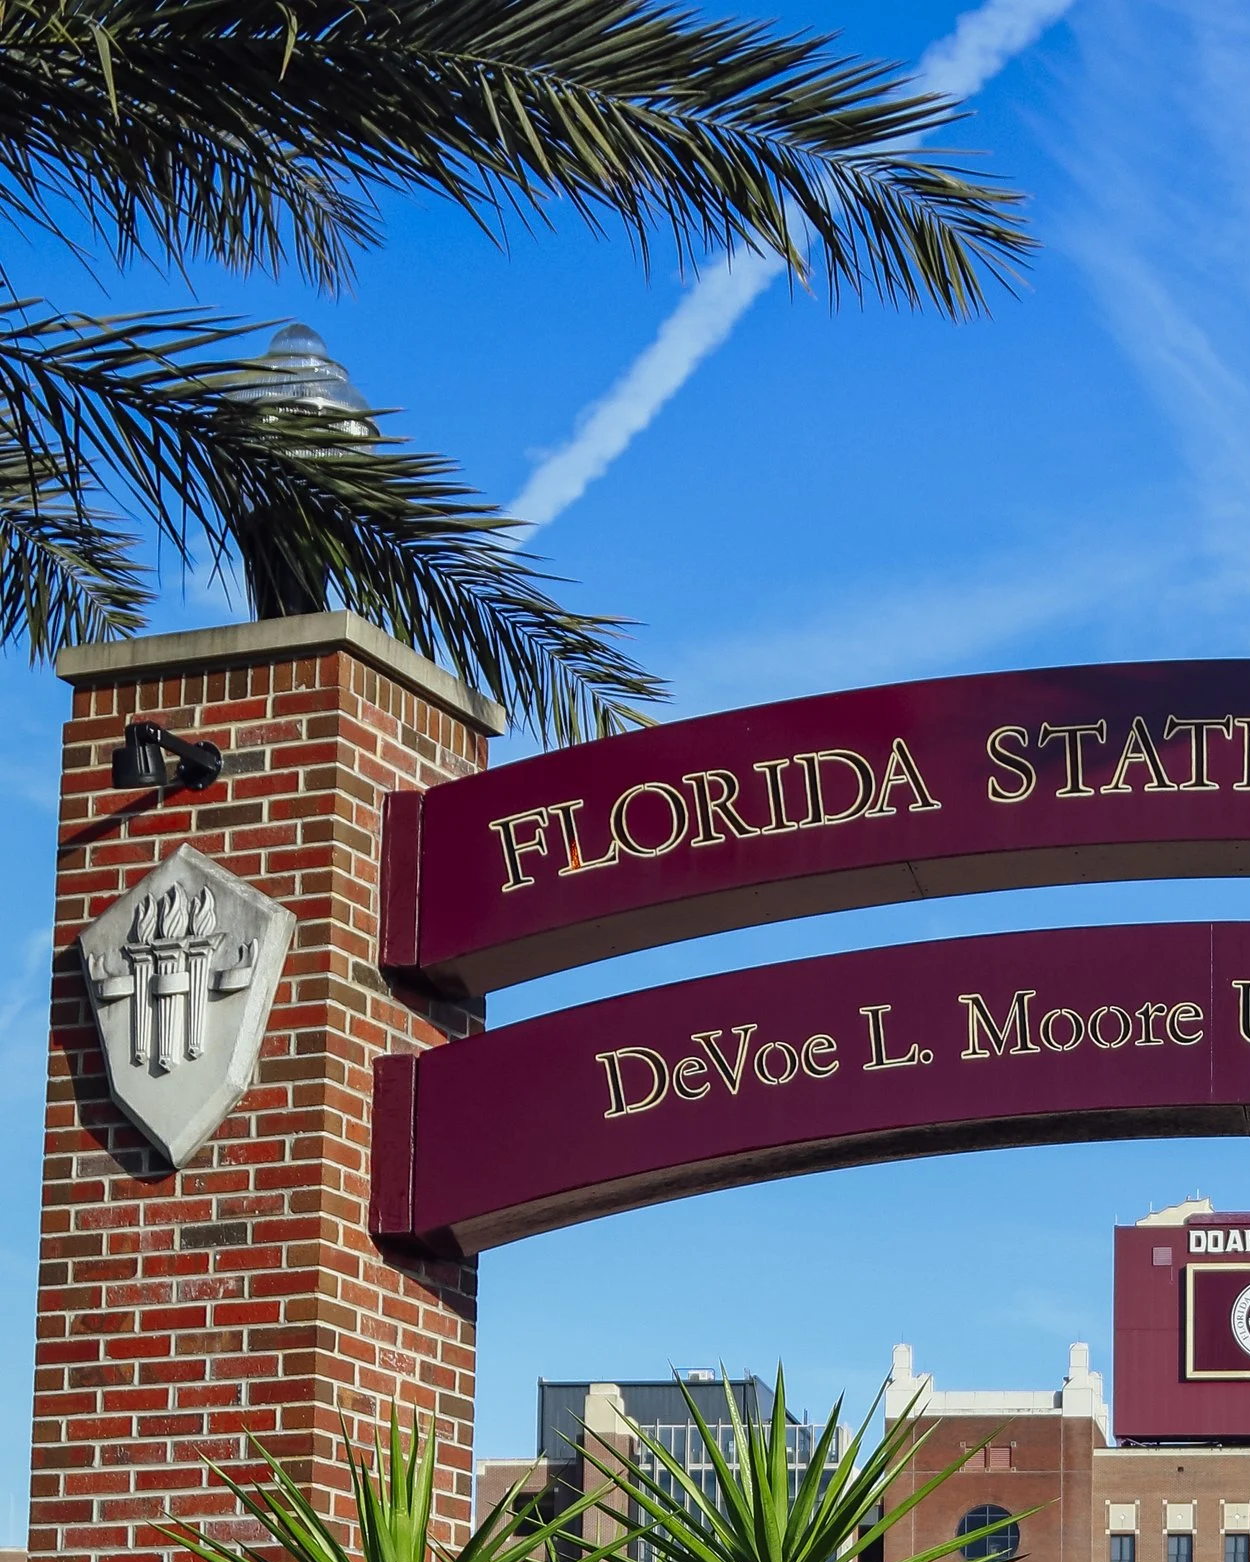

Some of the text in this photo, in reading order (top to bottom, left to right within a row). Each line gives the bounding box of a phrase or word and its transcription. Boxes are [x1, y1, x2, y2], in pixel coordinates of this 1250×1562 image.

[489, 736, 942, 893] FLORIDA
[595, 1023, 840, 1120] DeVoe
[859, 1004, 934, 1072] L.
[957, 989, 1205, 1060] Moore
